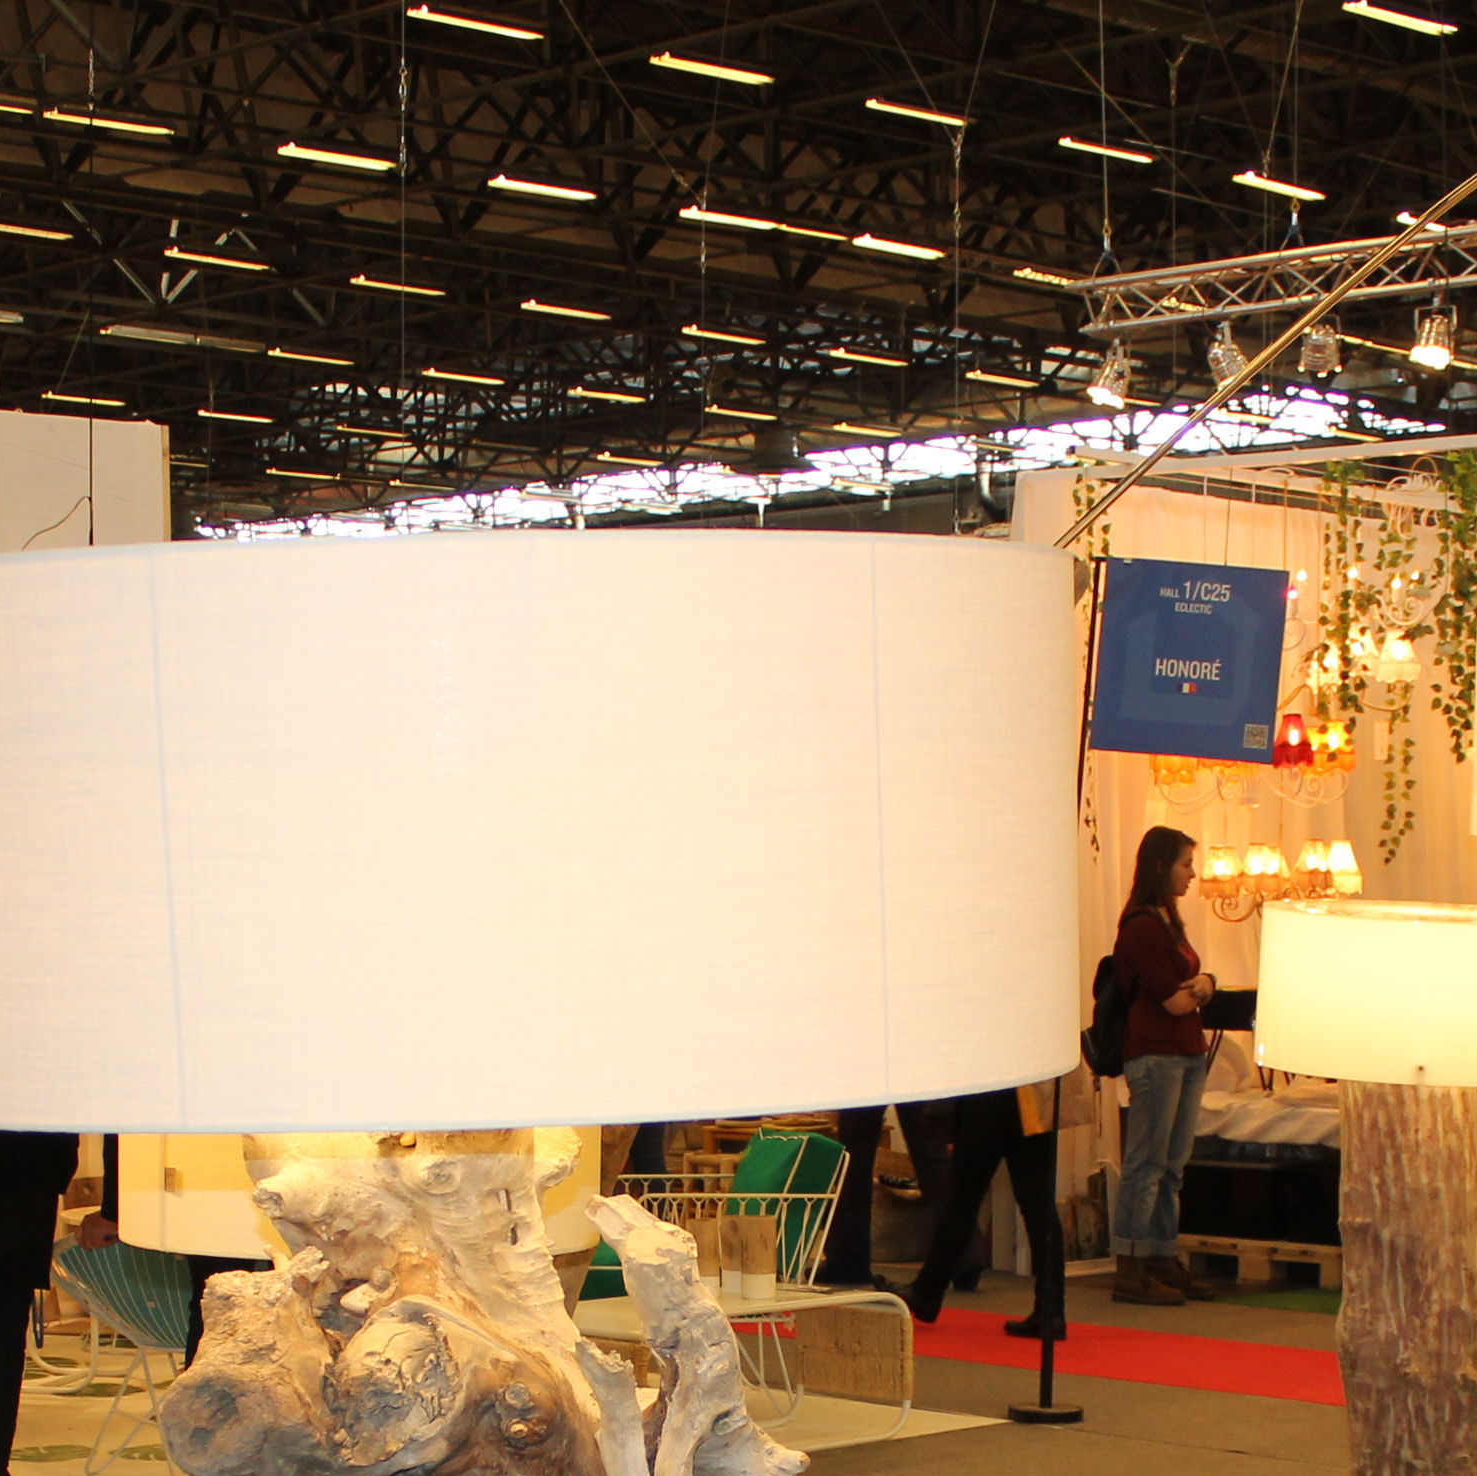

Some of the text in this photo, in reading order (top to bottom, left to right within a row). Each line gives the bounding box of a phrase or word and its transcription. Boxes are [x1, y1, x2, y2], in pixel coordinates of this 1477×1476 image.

[1159, 580, 1232, 603] HALL 1/C25
[1174, 602, 1213, 615] ECLECTIC
[1154, 658, 1223, 681] HONORÉ
